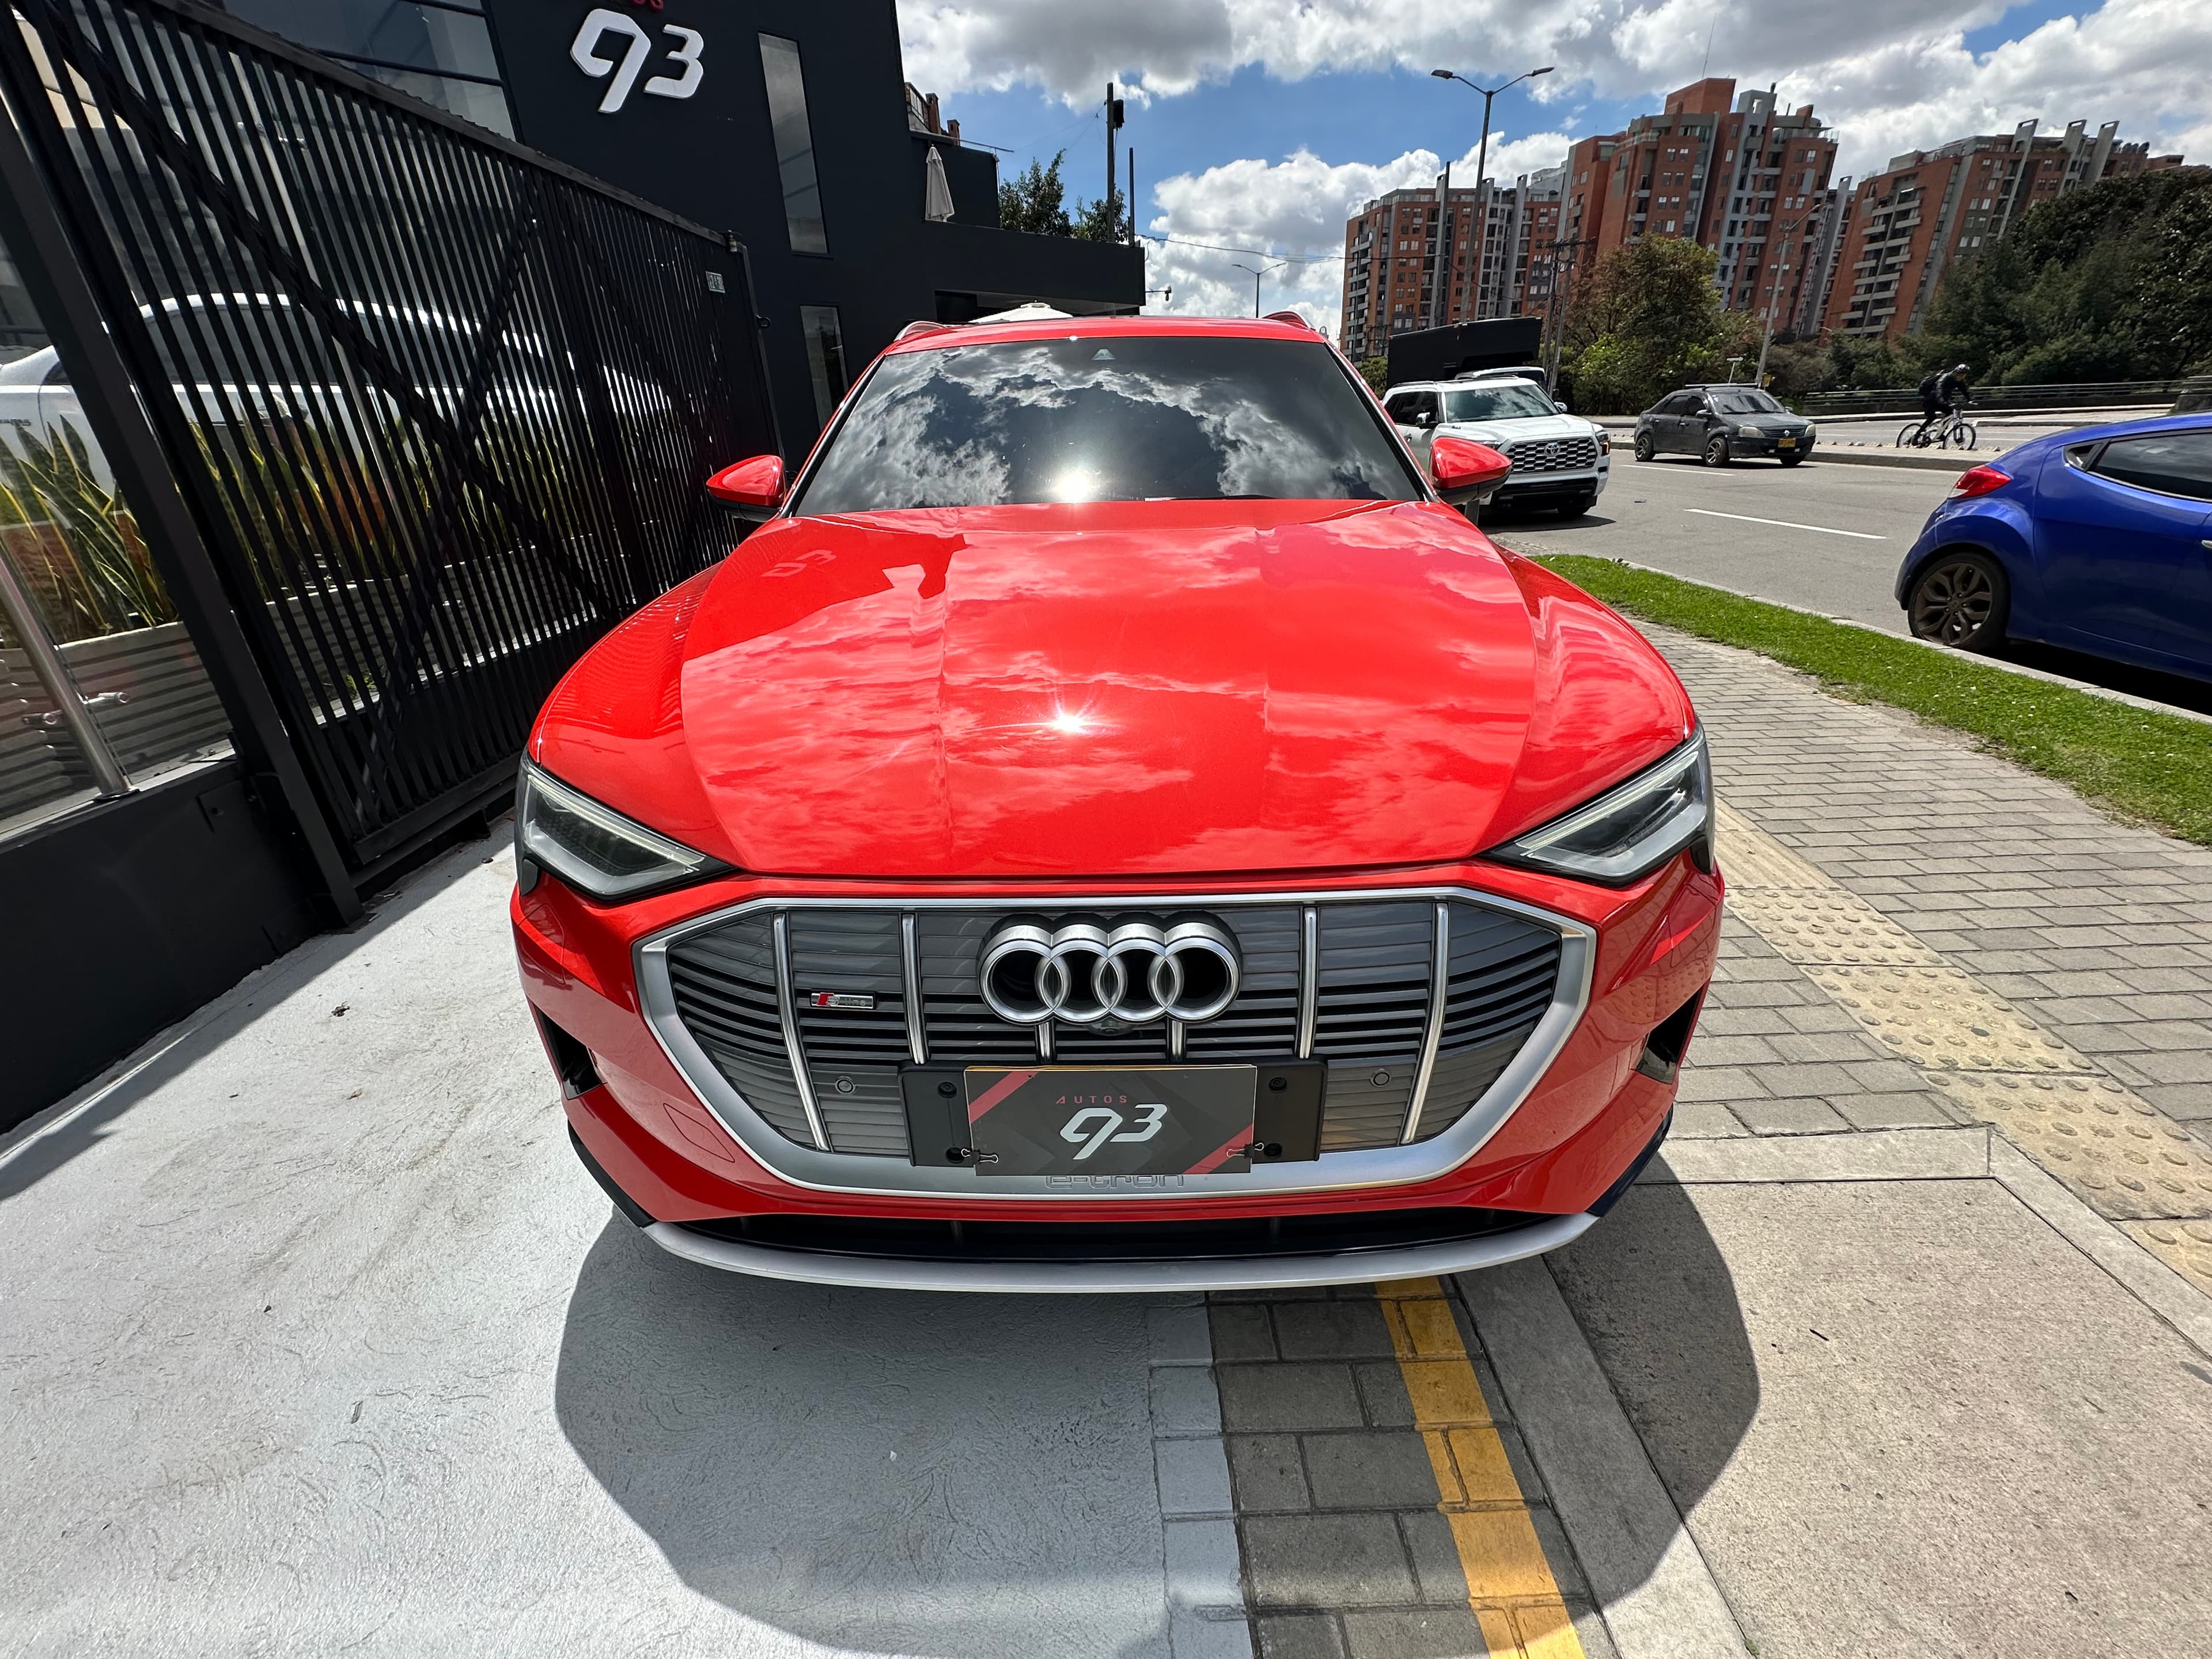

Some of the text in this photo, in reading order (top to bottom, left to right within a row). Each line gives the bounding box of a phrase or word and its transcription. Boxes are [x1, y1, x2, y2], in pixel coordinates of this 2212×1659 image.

[570, 8, 704, 113] 93
[825, 996, 840, 1006] S
[1055, 1095, 1127, 1104] AUTOS
[1059, 1104, 1168, 1160] 93
[1046, 1175, 1184, 1189] e-tron
